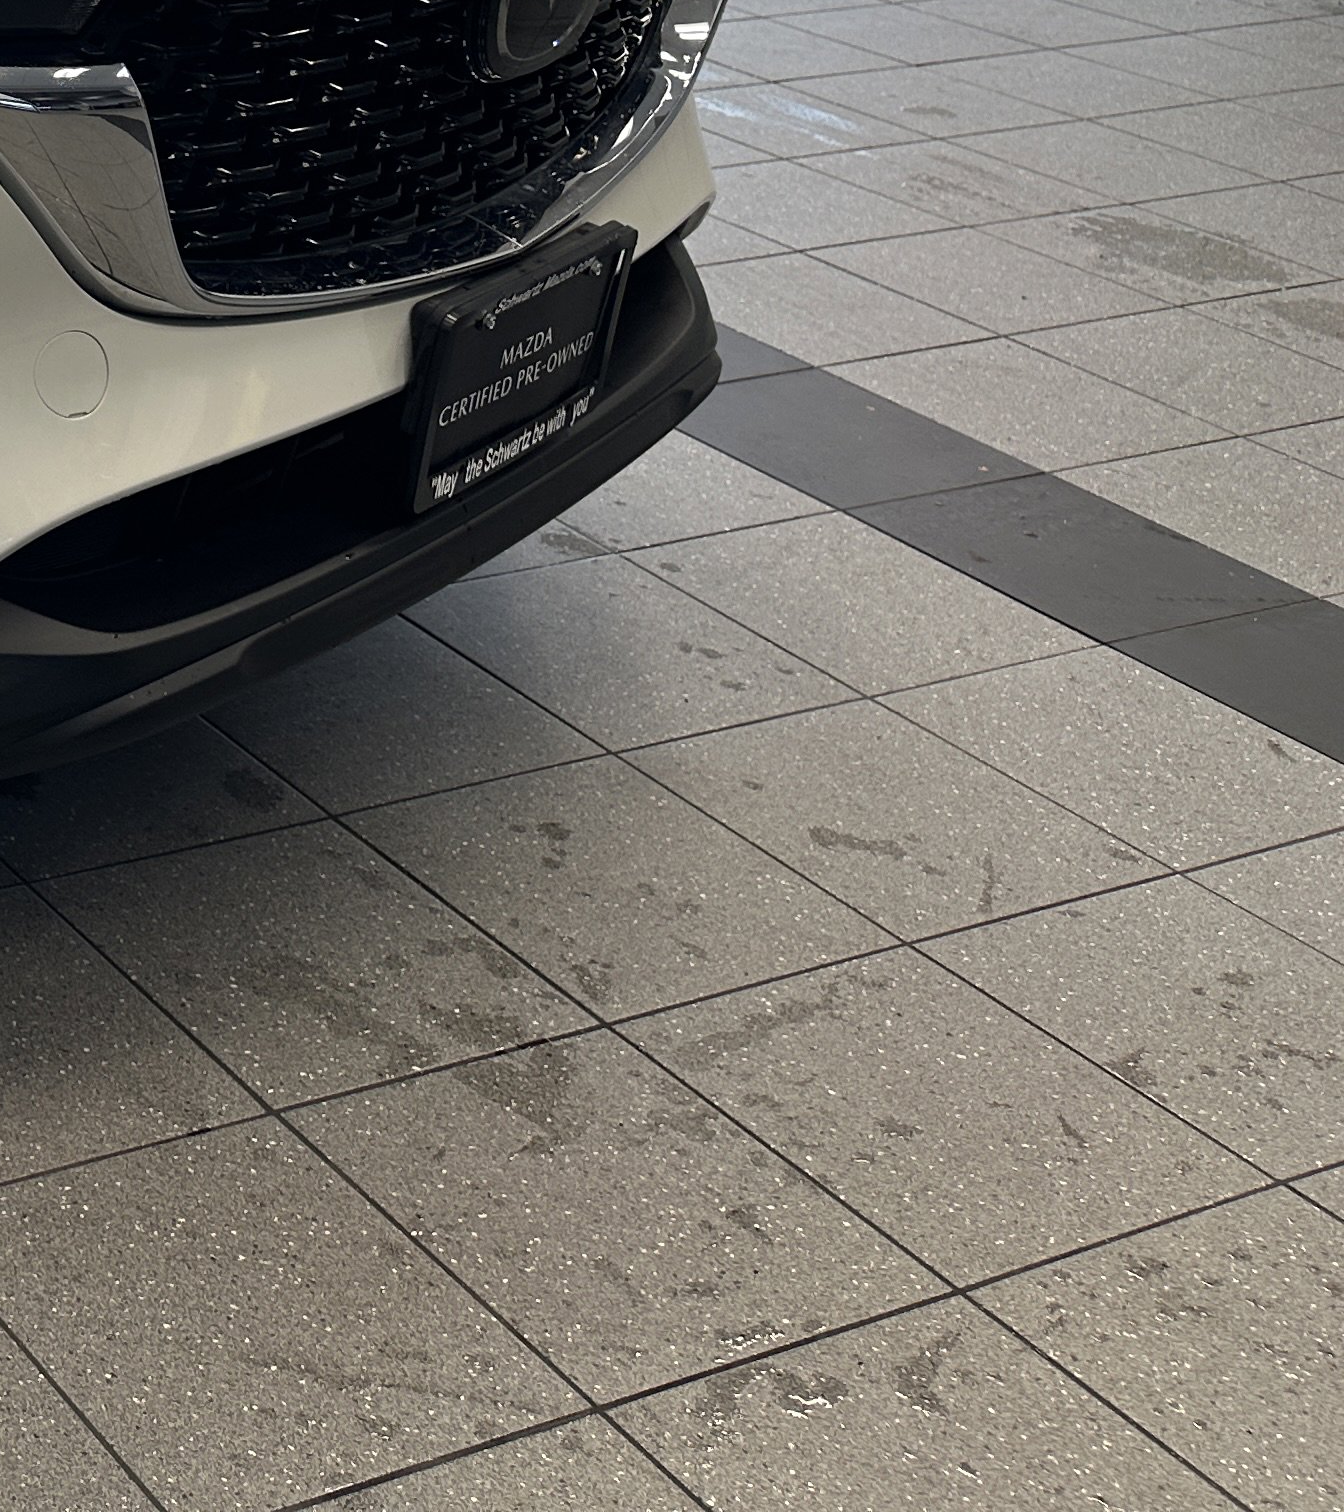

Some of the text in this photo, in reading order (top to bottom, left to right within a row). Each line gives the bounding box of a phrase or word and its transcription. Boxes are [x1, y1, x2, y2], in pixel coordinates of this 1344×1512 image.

[438, 331, 595, 427] CERTIFIED PRE-OWNED
[499, 326, 553, 370] MAZDA
[464, 457, 484, 484] the
[483, 428, 532, 473] Schwartz
[531, 420, 546, 445] be
[545, 404, 567, 437] with
